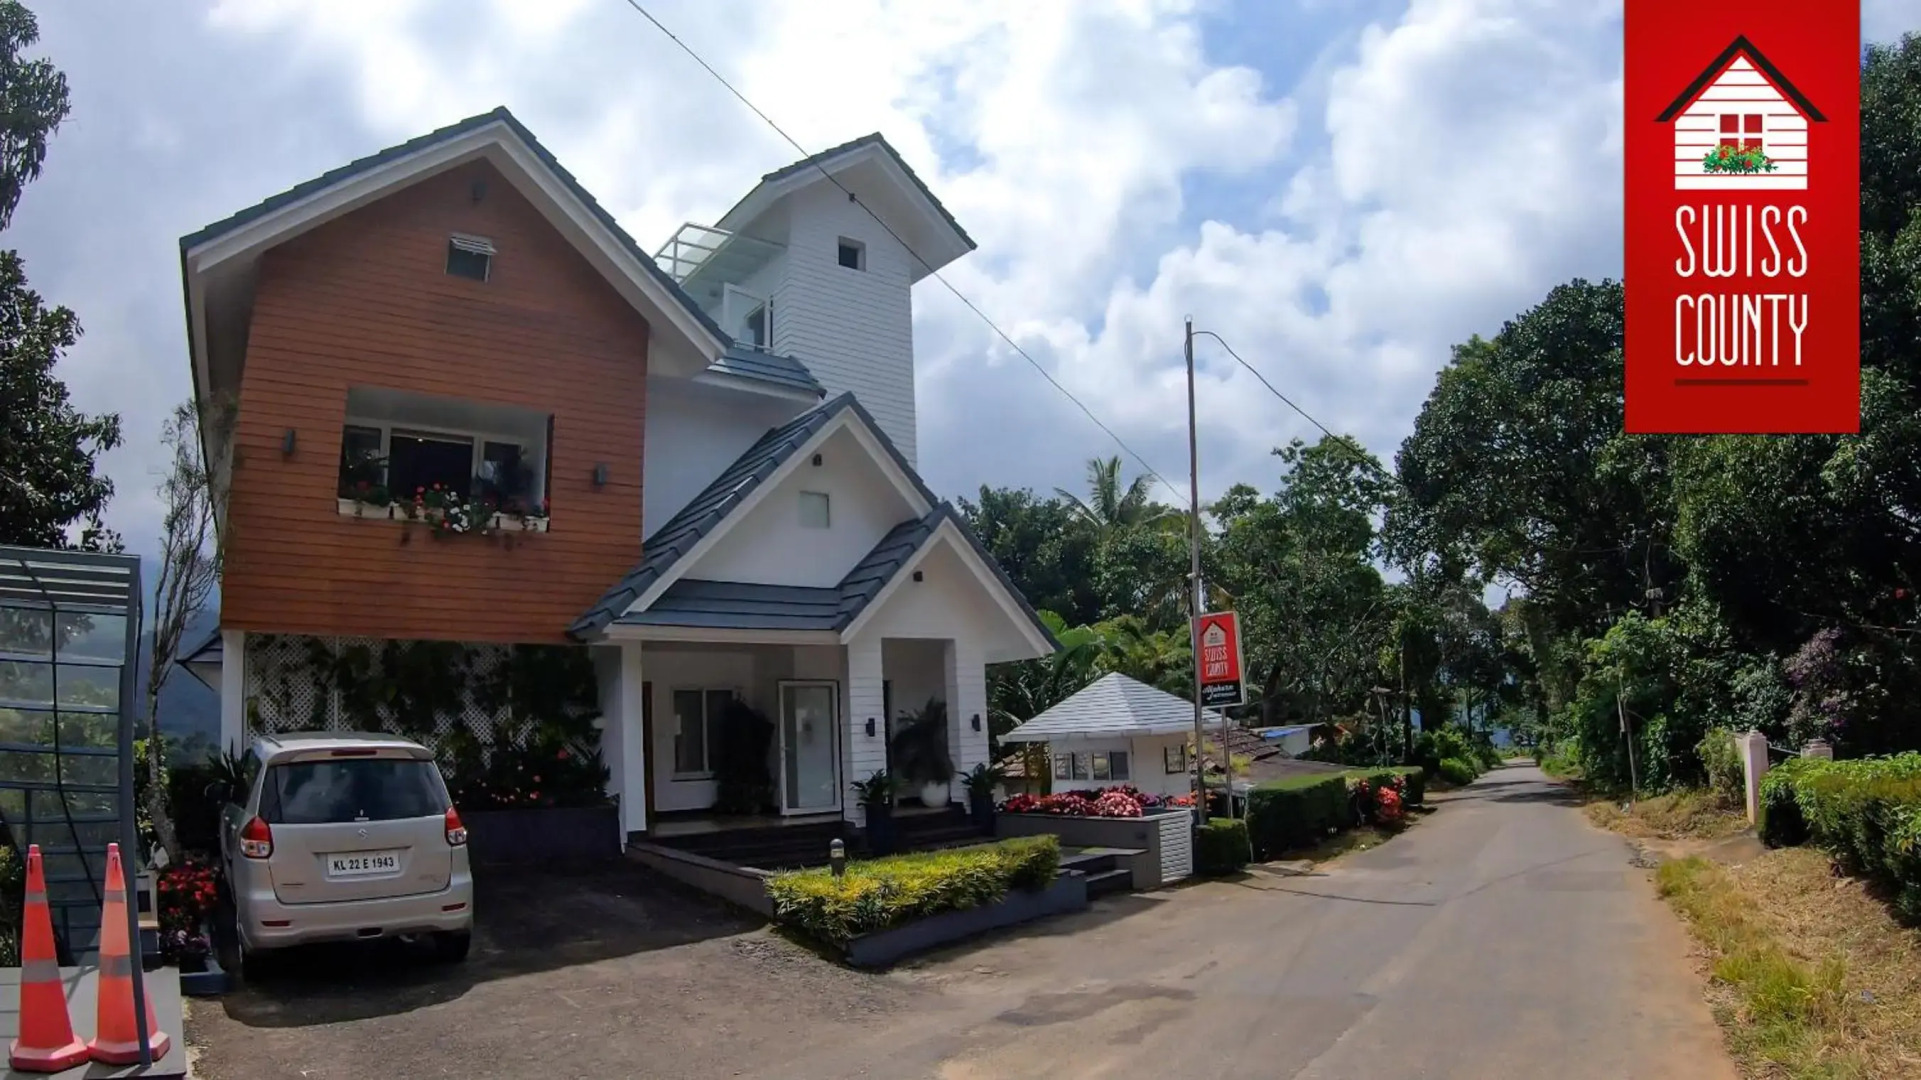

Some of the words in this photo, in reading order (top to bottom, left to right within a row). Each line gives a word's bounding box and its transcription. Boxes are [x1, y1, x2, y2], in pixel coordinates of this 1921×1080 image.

[1204, 646, 1228, 662] SWISS
[333, 860, 347, 871] KL
[348, 858, 361, 870] 22
[363, 858, 369, 869] E
[372, 856, 394, 868] 1943
